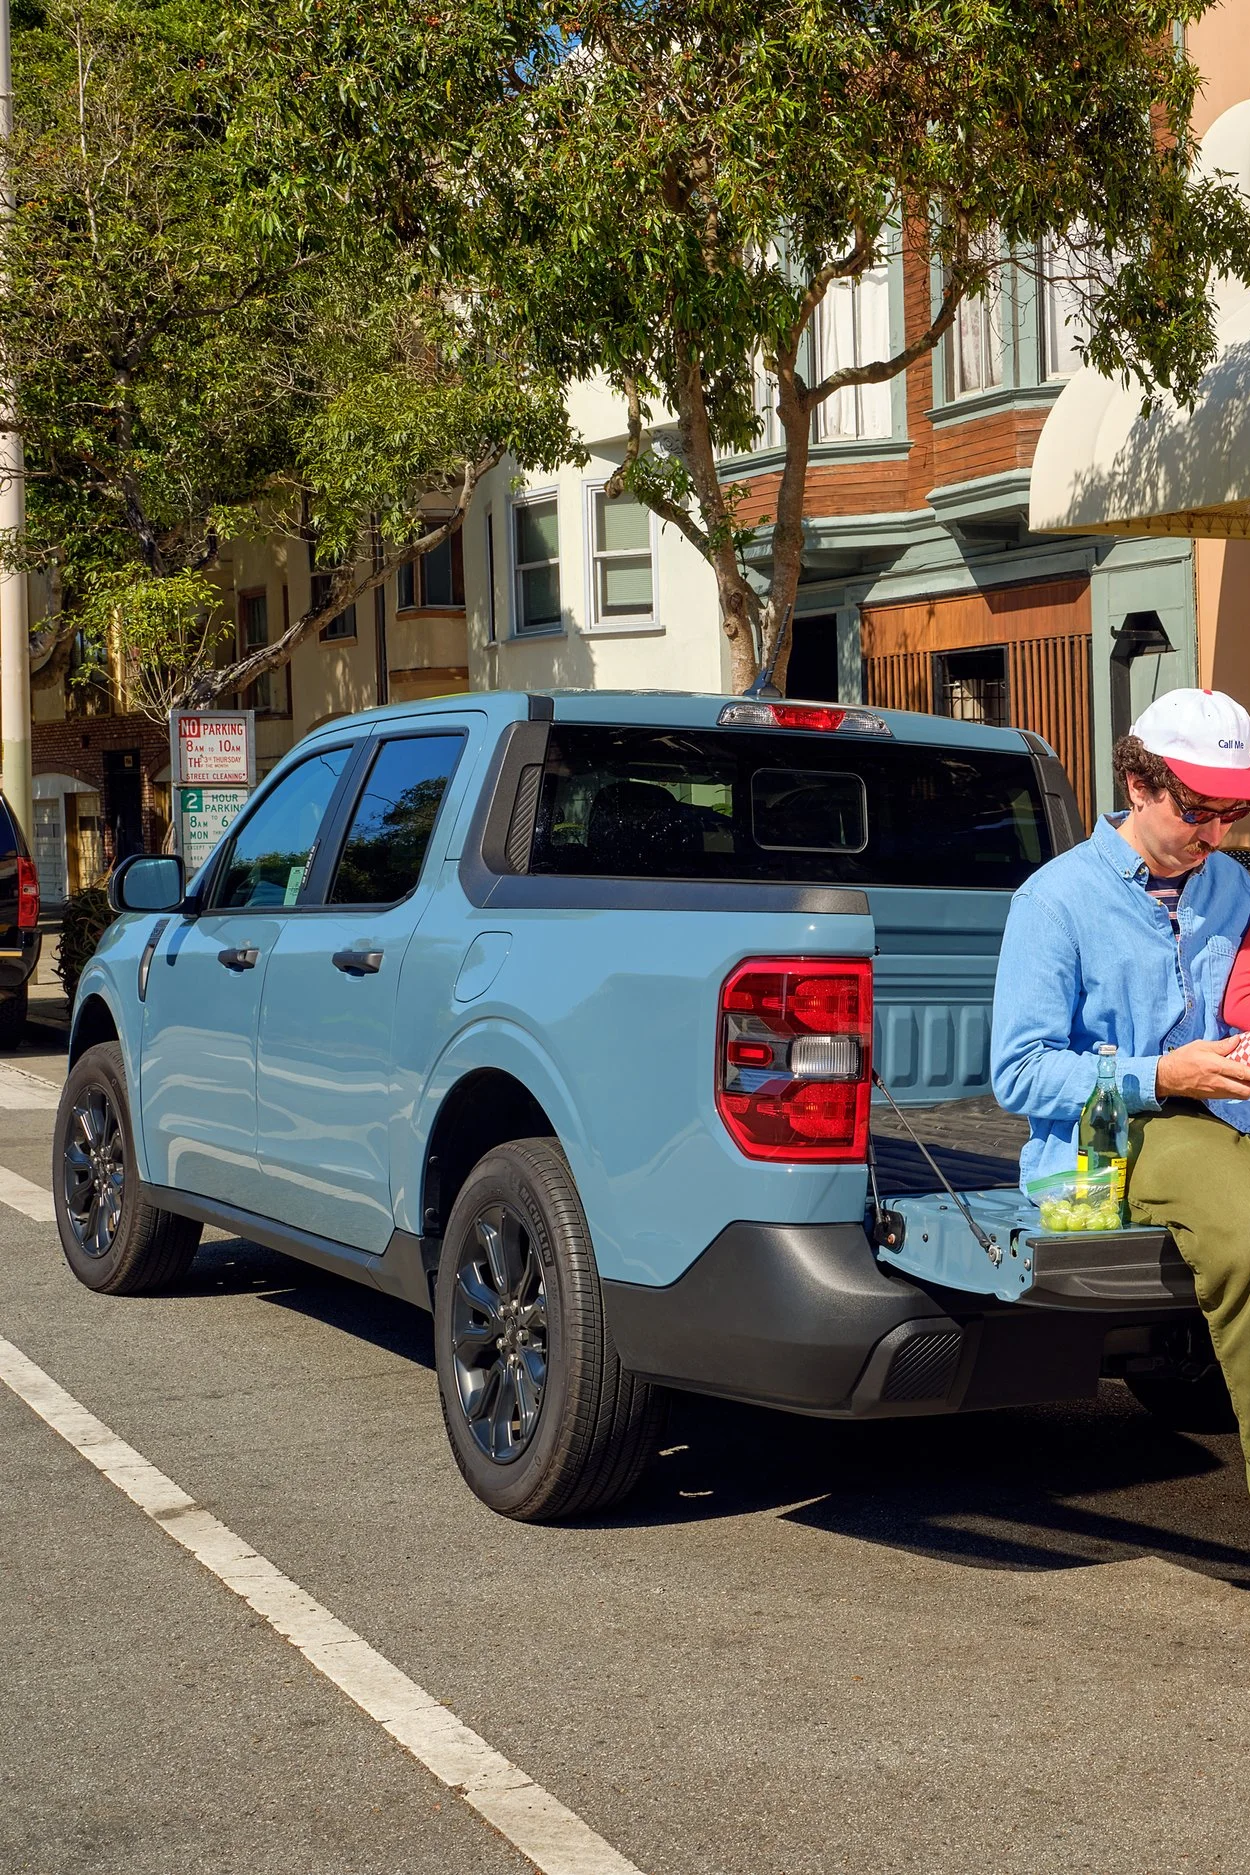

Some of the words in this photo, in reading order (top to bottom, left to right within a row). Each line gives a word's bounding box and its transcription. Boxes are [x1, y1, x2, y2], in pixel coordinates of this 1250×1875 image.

[181, 719, 199, 736] NO
[202, 723, 243, 736] PARKING
[1218, 739, 1233, 749] Call
[1234, 740, 1245, 750] Me
[186, 792, 198, 809] 2
[211, 794, 239, 803] HOUR
[190, 831, 209, 840] MON
[520, 1187, 553, 1267] MICHELIN
